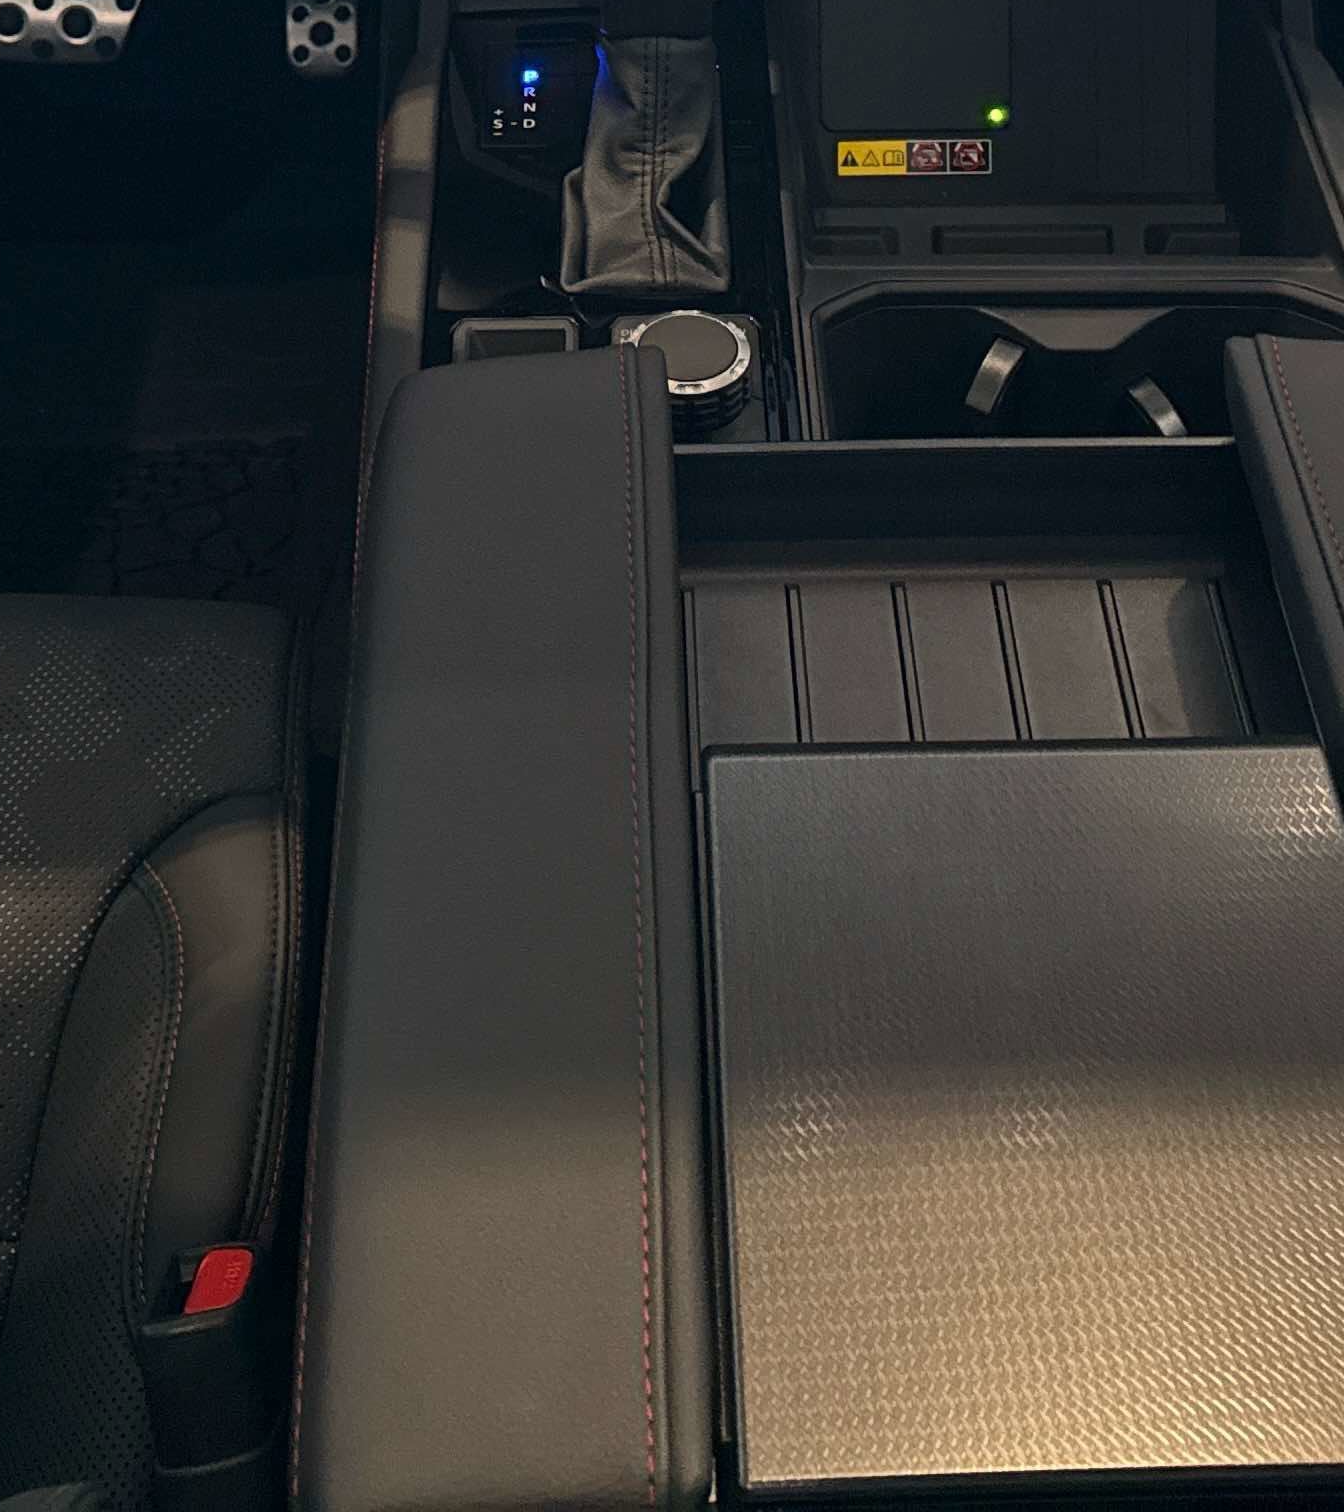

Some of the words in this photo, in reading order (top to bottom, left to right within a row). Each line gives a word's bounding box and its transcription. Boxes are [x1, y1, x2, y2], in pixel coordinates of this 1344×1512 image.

[523, 70, 539, 83] P
[523, 87, 536, 97] R
[523, 102, 536, 113] N
[493, 118, 503, 129] S
[523, 118, 536, 129] D
